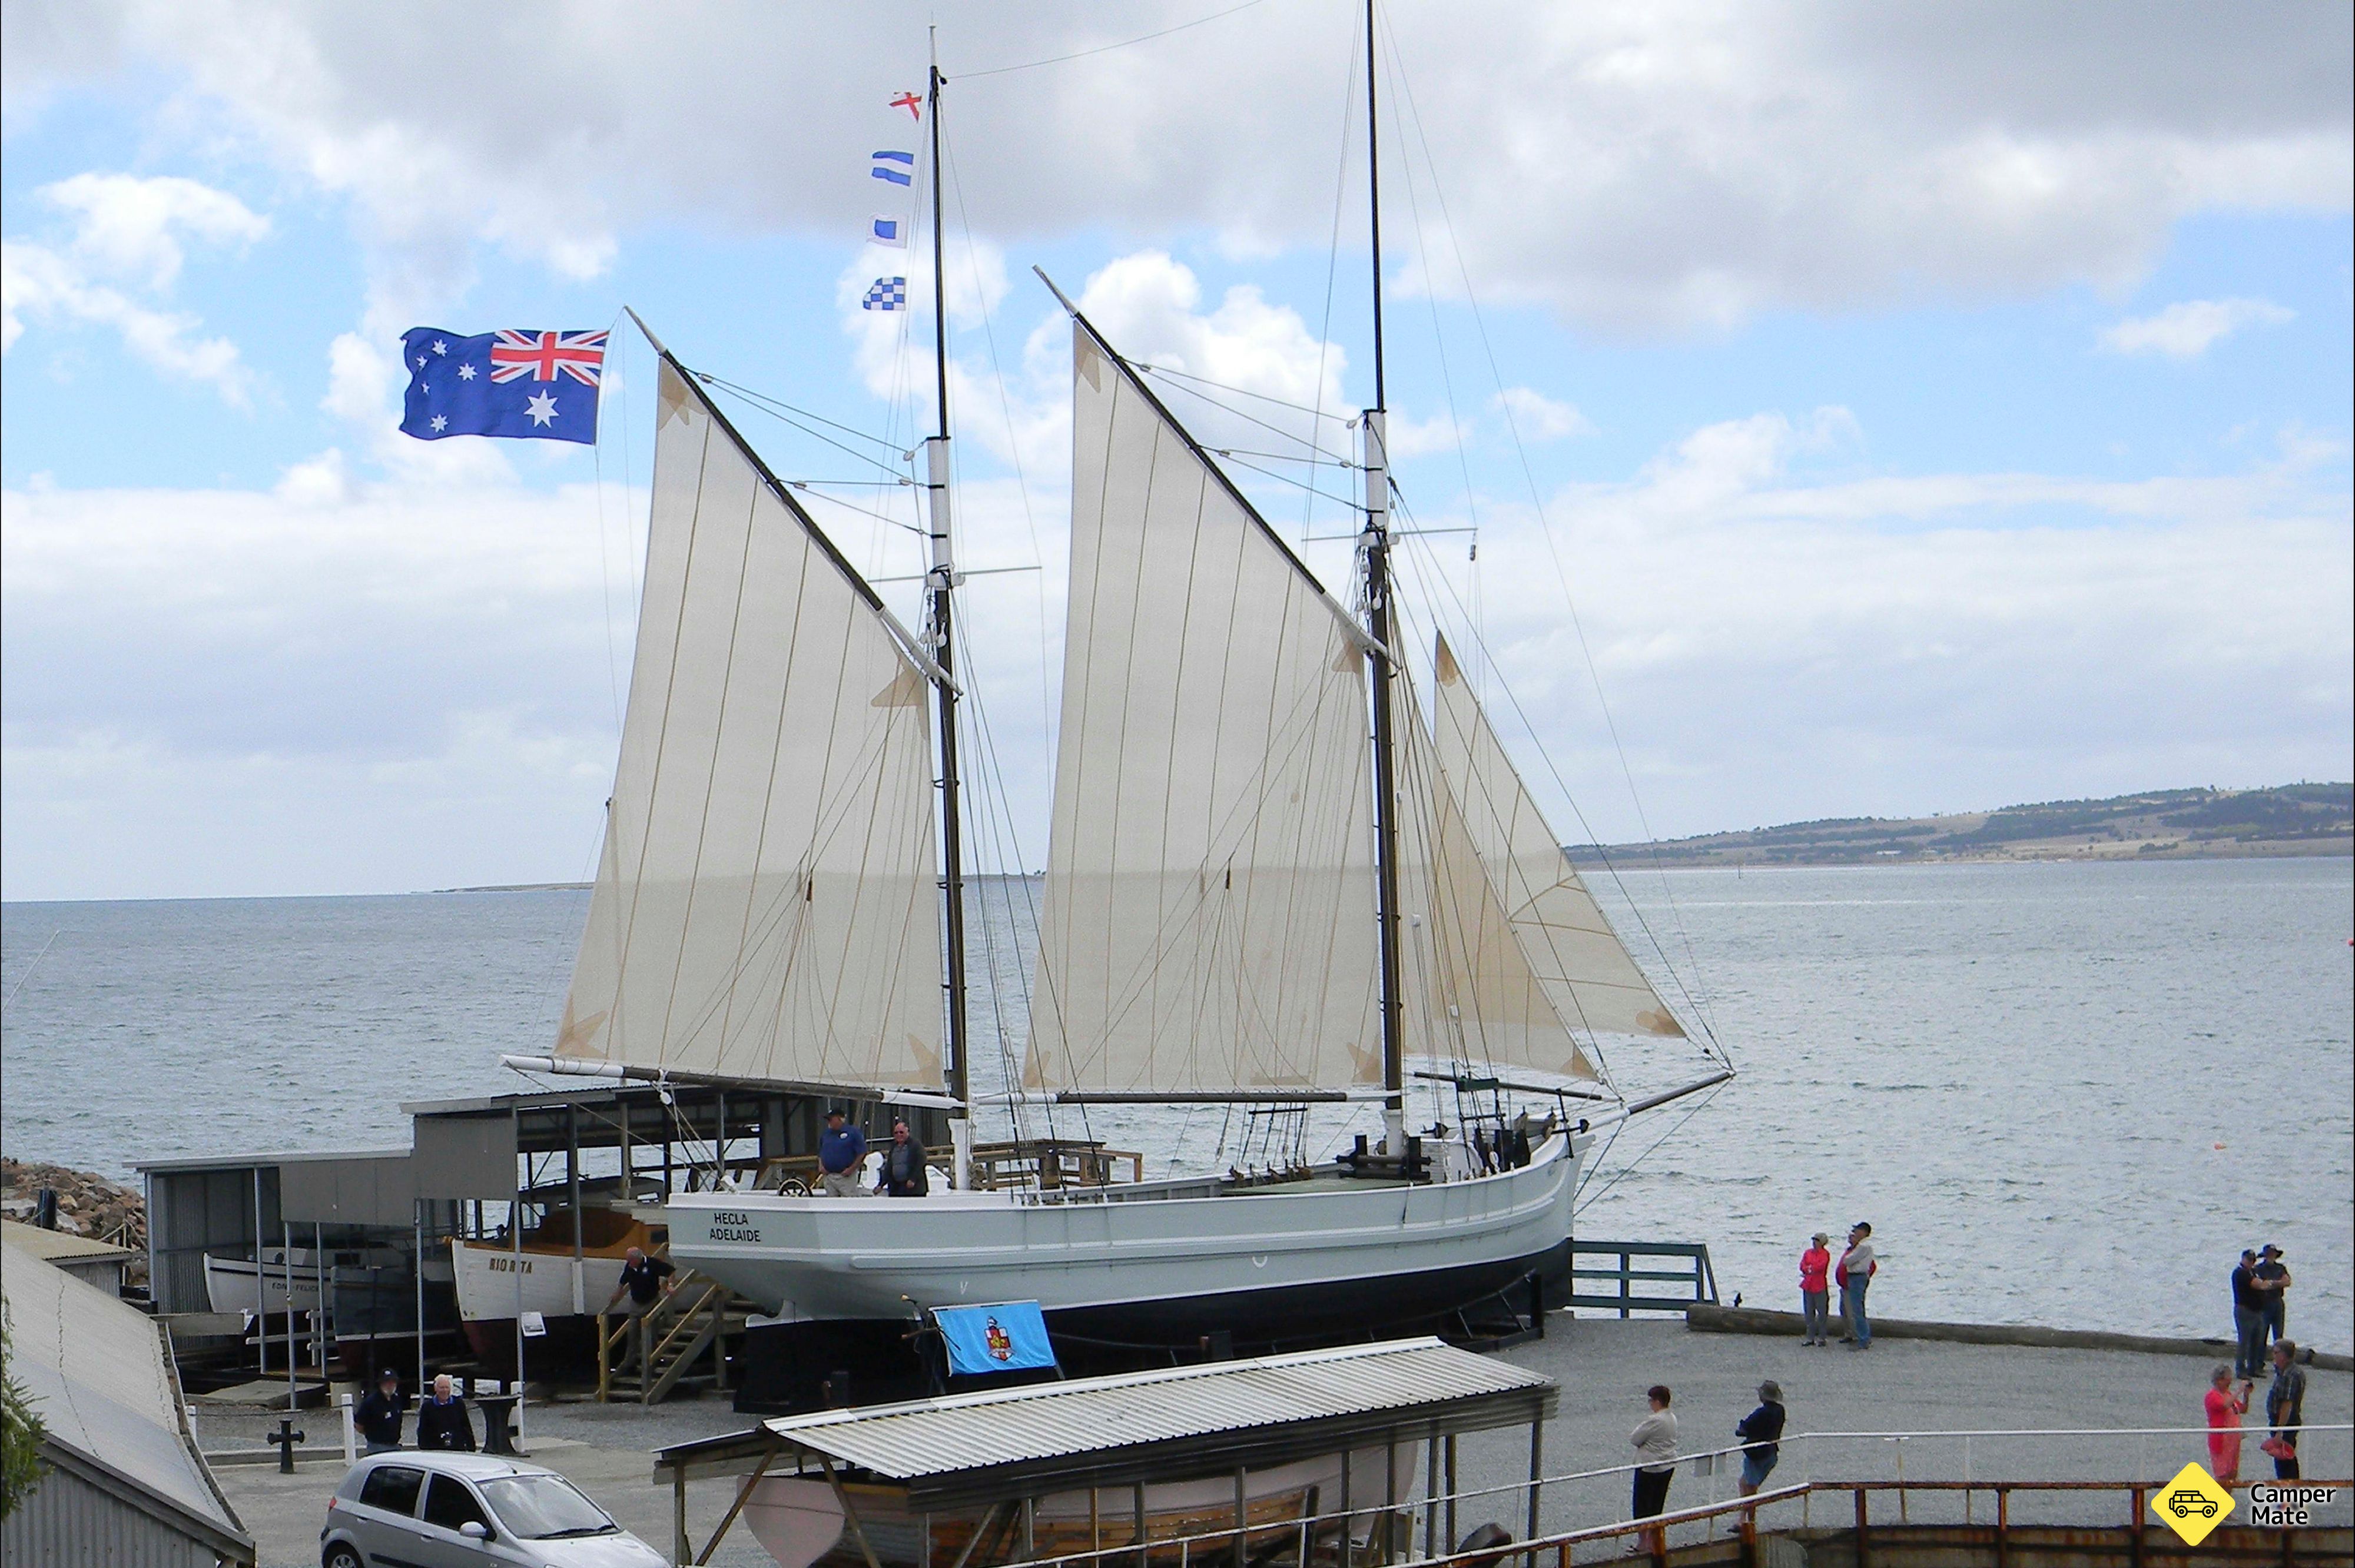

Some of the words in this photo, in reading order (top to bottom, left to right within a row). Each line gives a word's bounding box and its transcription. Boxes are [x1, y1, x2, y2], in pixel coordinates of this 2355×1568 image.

[714, 1212, 748, 1225] HECLA
[709, 1228, 761, 1242] ADELAIDE
[489, 1258, 507, 1272] RIO
[509, 1260, 532, 1274] RTA
